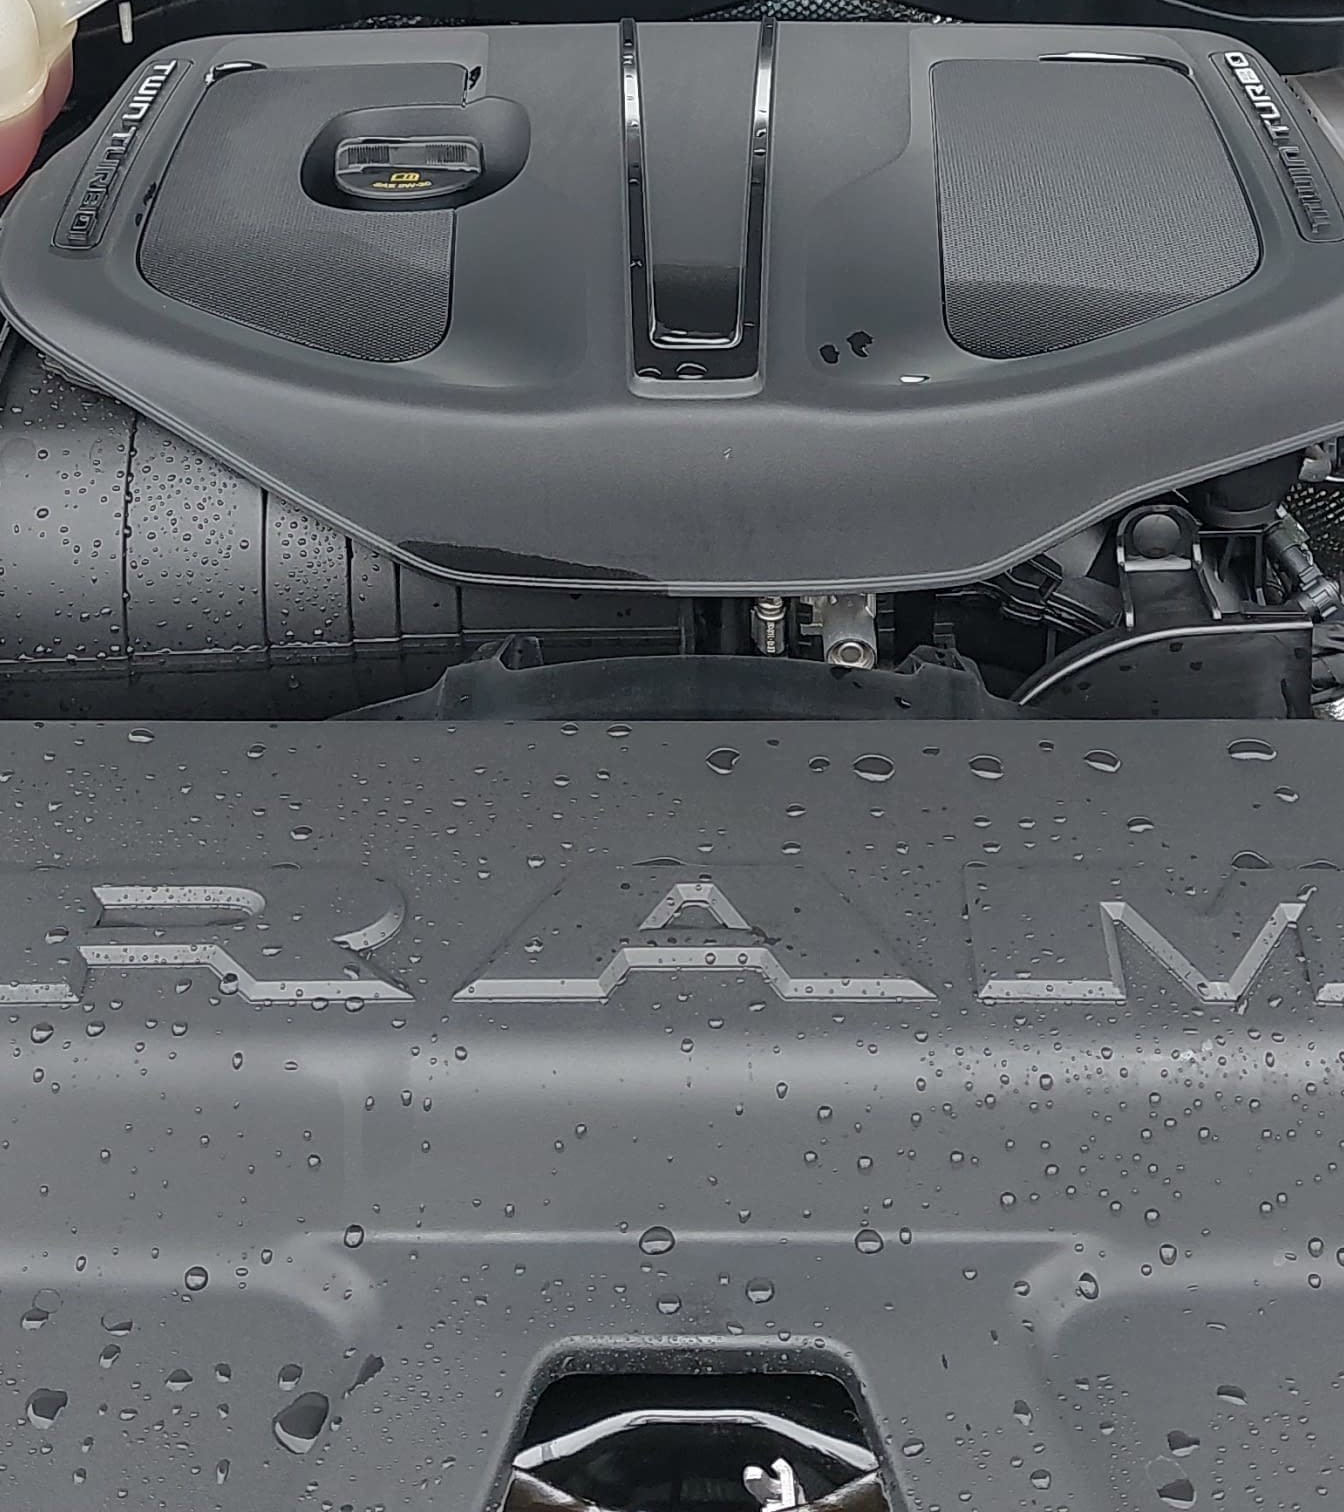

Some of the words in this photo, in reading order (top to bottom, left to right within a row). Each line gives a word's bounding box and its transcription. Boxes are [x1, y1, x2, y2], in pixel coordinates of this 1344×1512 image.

[122, 59, 178, 122] TWIN
[1223, 51, 1291, 147] TURBO
[67, 125, 138, 242] TURBO
[1278, 145, 1331, 235] TWIN
